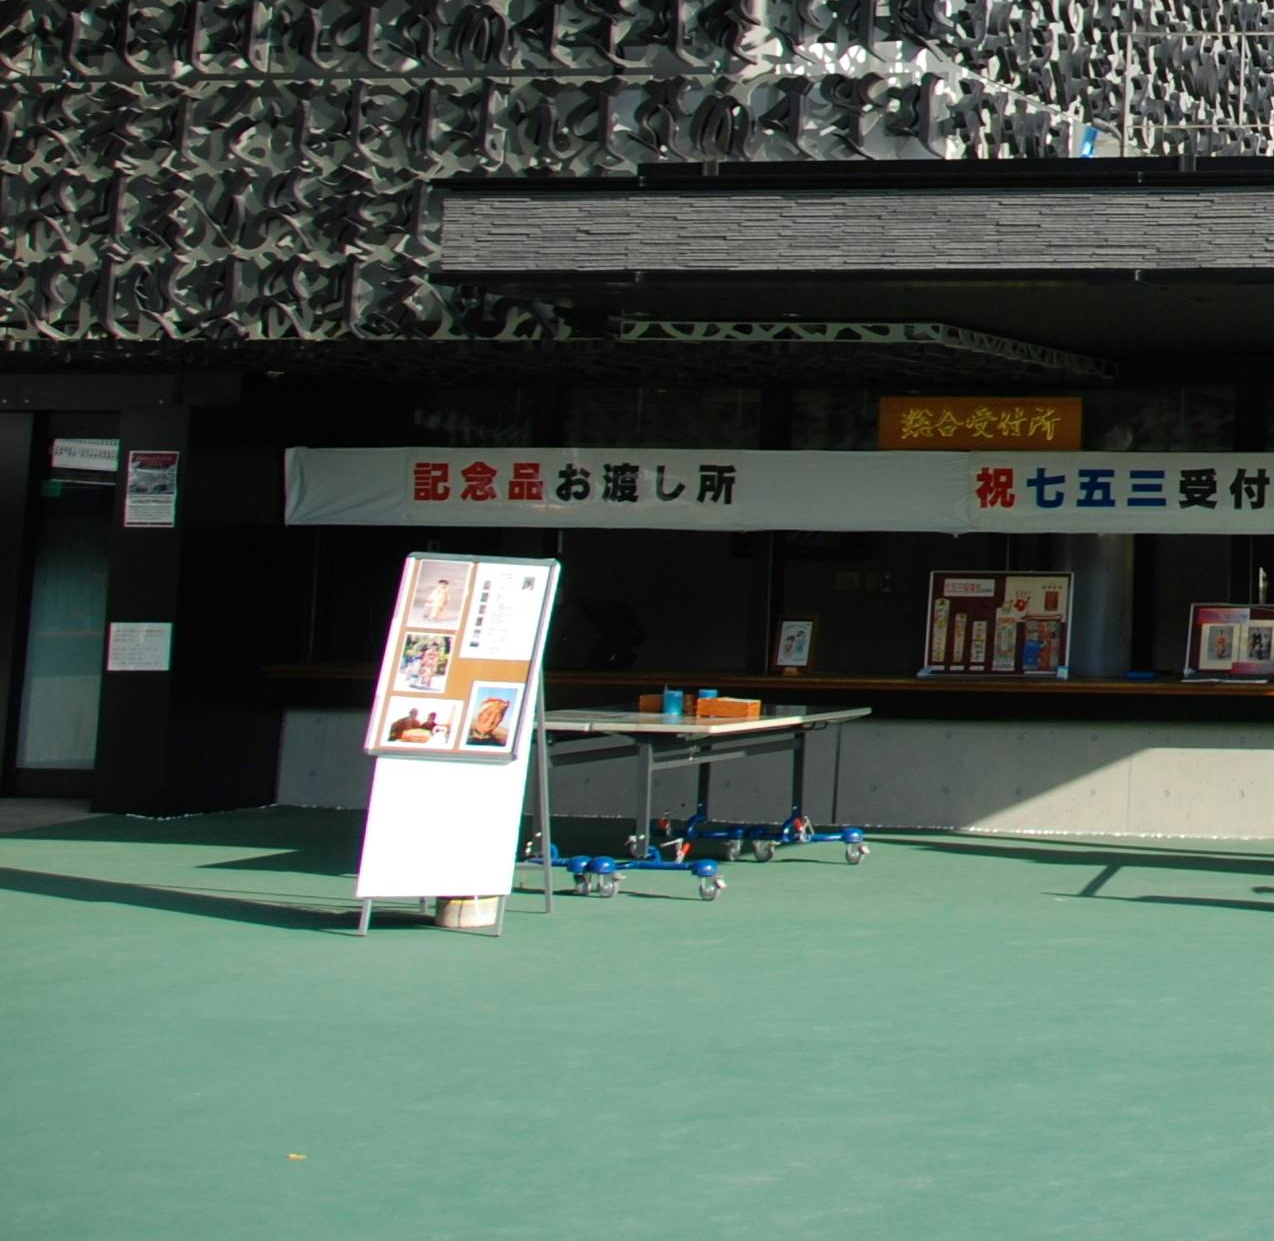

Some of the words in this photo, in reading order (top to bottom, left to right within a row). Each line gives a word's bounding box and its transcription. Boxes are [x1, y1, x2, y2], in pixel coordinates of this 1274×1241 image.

[900, 406, 1061, 441] 総合受付所
[413, 461, 736, 505] 記念品お渡し所
